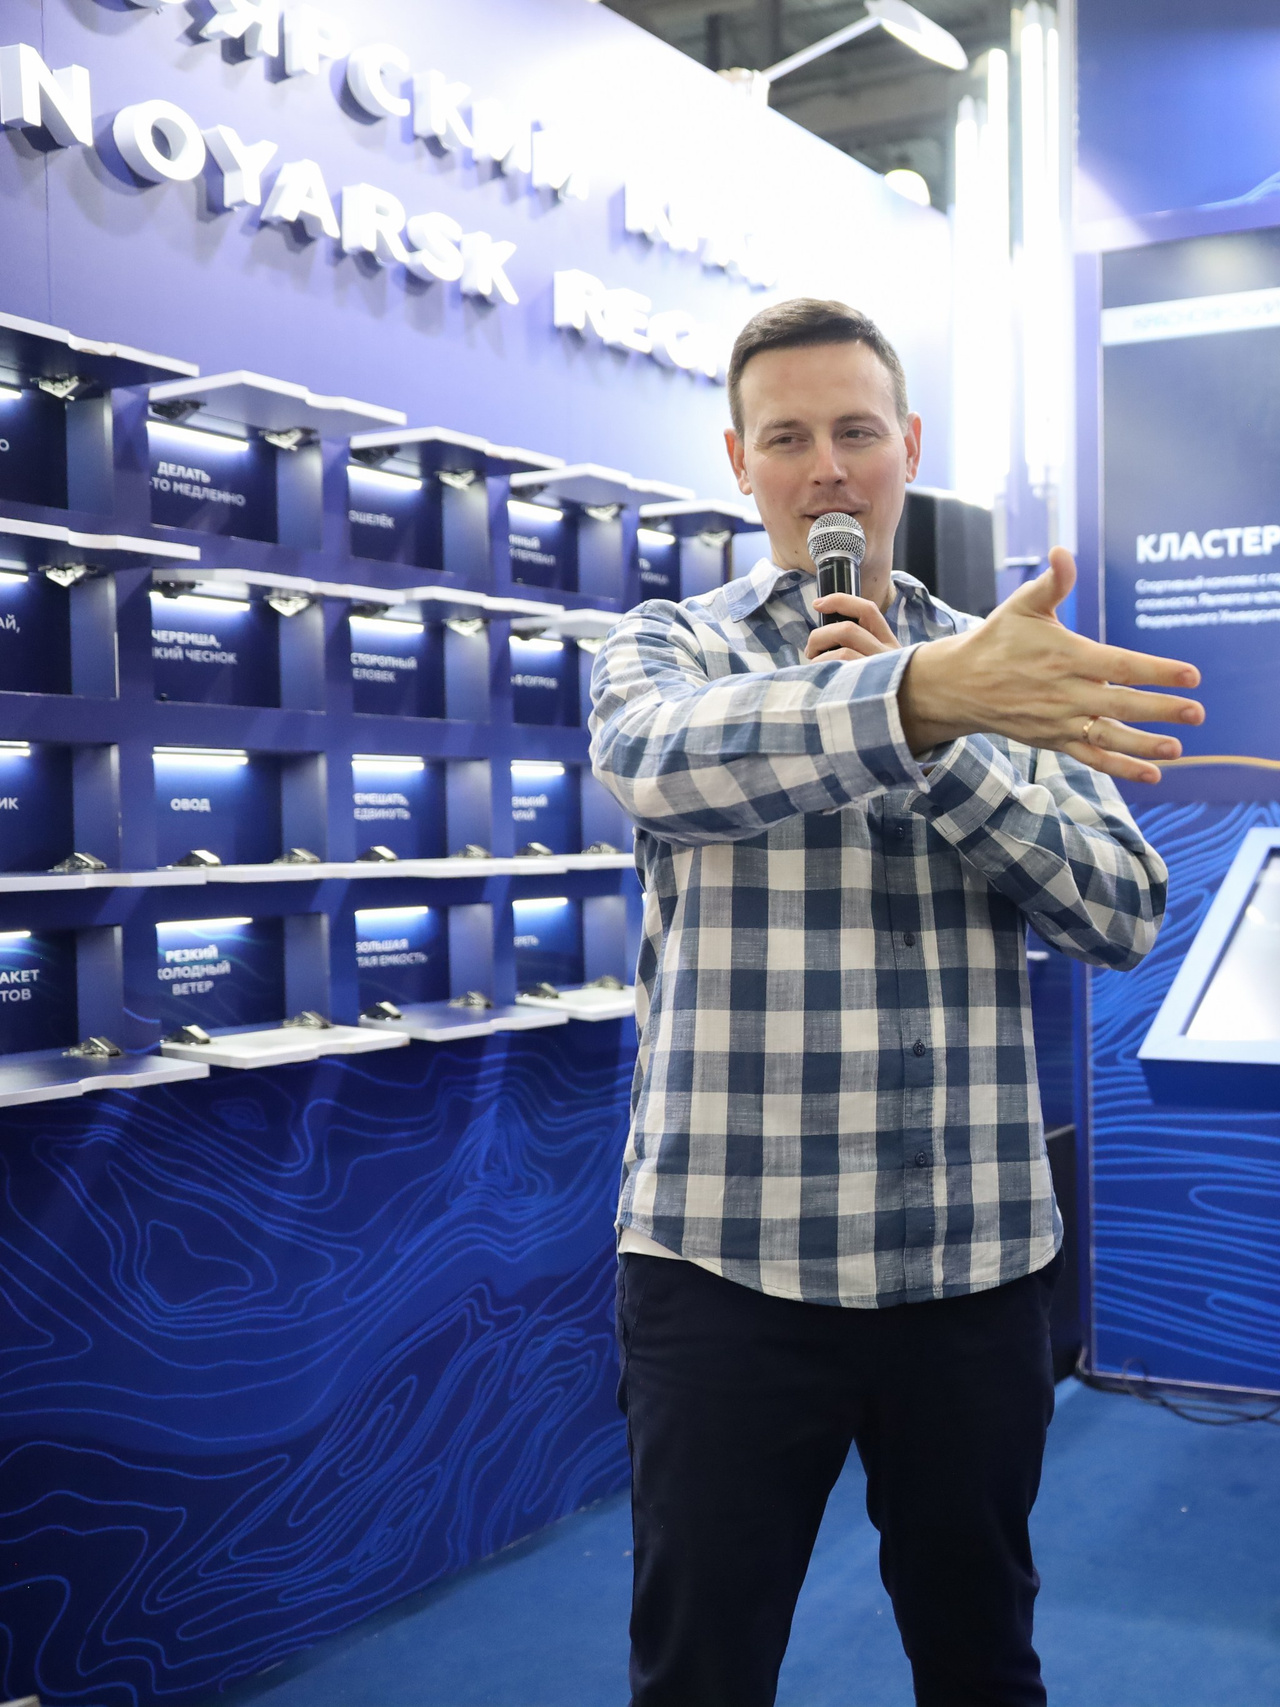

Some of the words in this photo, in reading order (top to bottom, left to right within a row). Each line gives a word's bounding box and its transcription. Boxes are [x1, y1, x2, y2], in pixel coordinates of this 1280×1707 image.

[157, 461, 211, 484] ДЕЛАТЬ
[172, 481, 246, 507] МЕДЛЕННО
[151, 629, 221, 649] ЧЕРЕМША,
[185, 648, 238, 665] ЧЕСНОК
[170, 798, 211, 813] ОВОД
[165, 944, 219, 964] РЕЗКИЙ
[172, 980, 214, 996] ВЕТЕР
